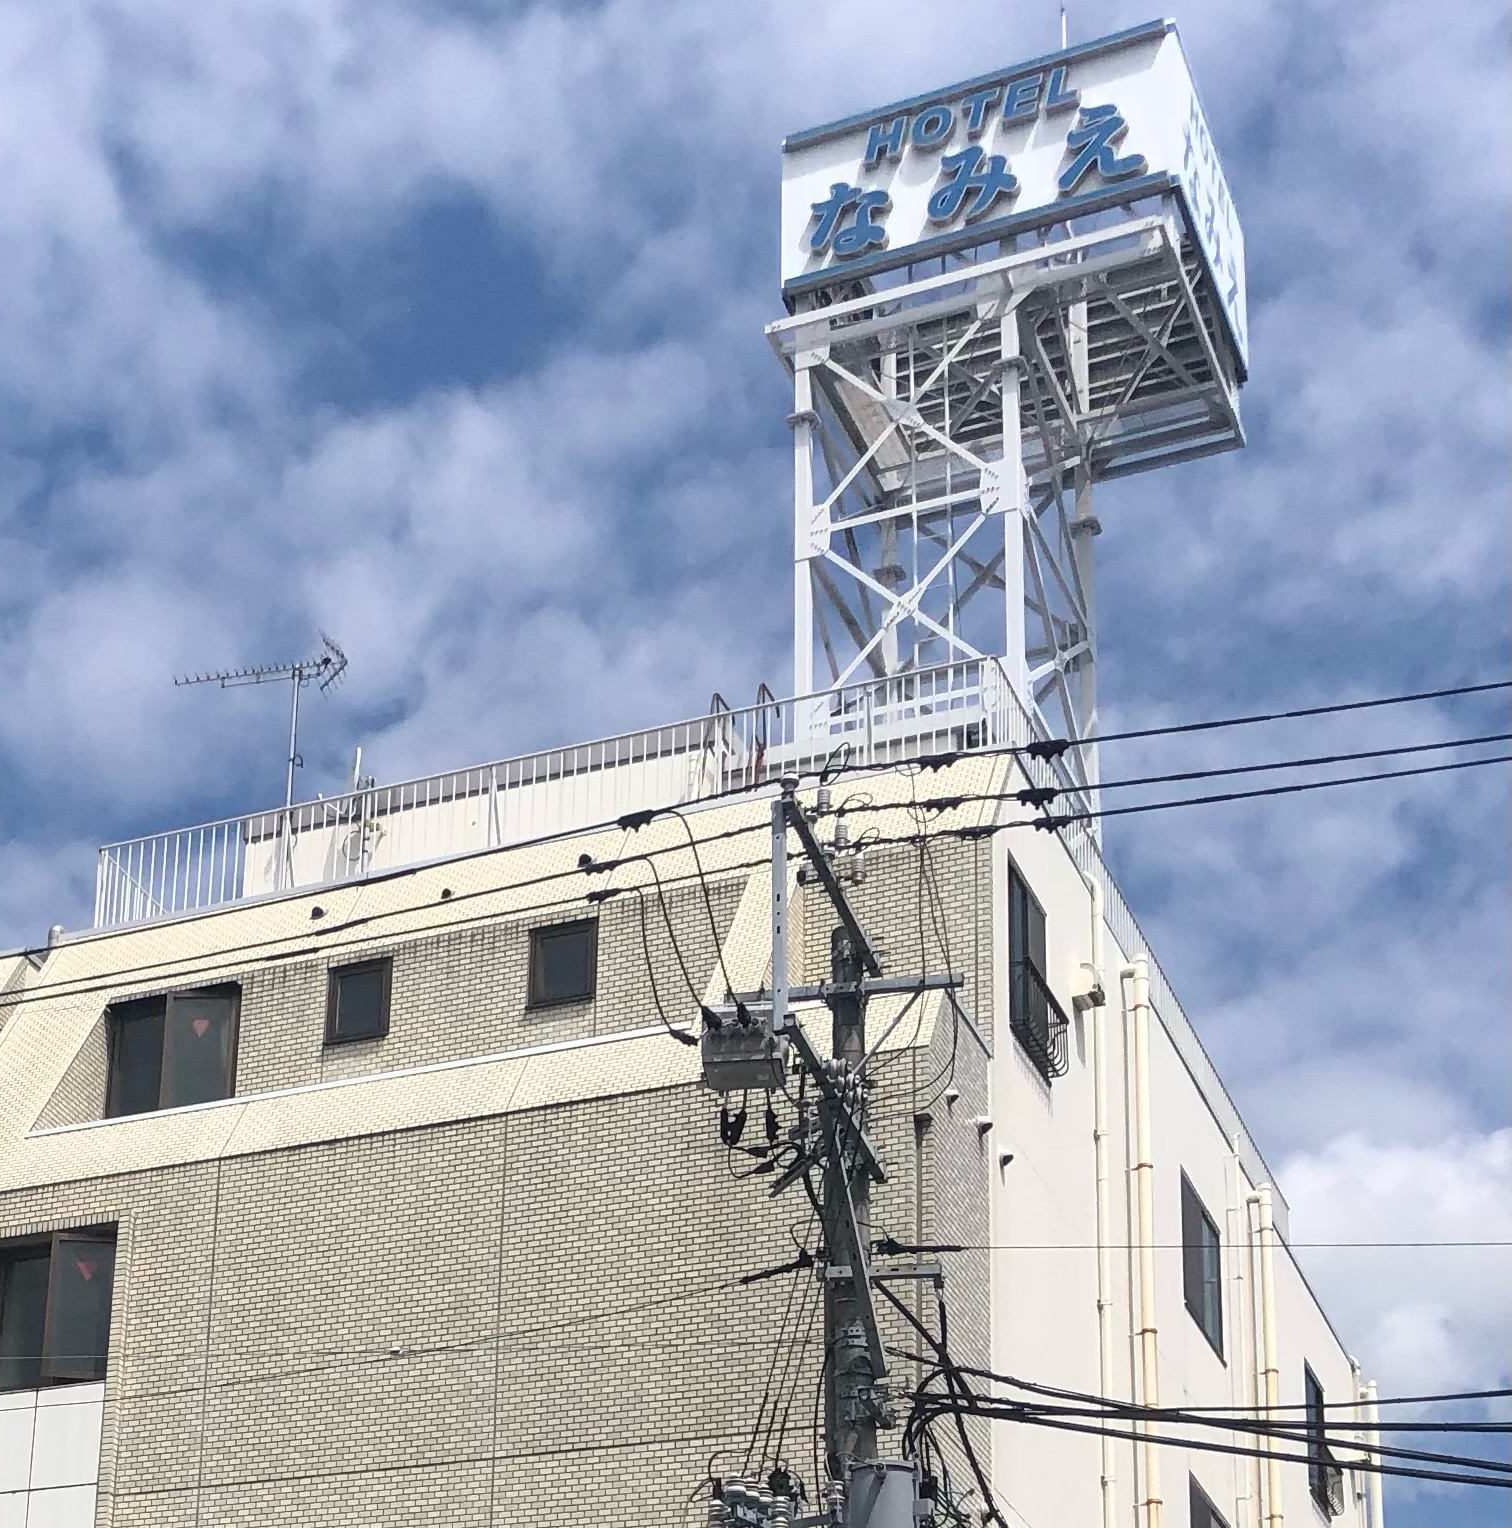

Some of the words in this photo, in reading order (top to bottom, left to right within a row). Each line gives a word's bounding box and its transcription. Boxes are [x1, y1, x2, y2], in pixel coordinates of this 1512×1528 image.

[811, 104, 1149, 255] なみえ
[865, 66, 1080, 168] HOTEL
